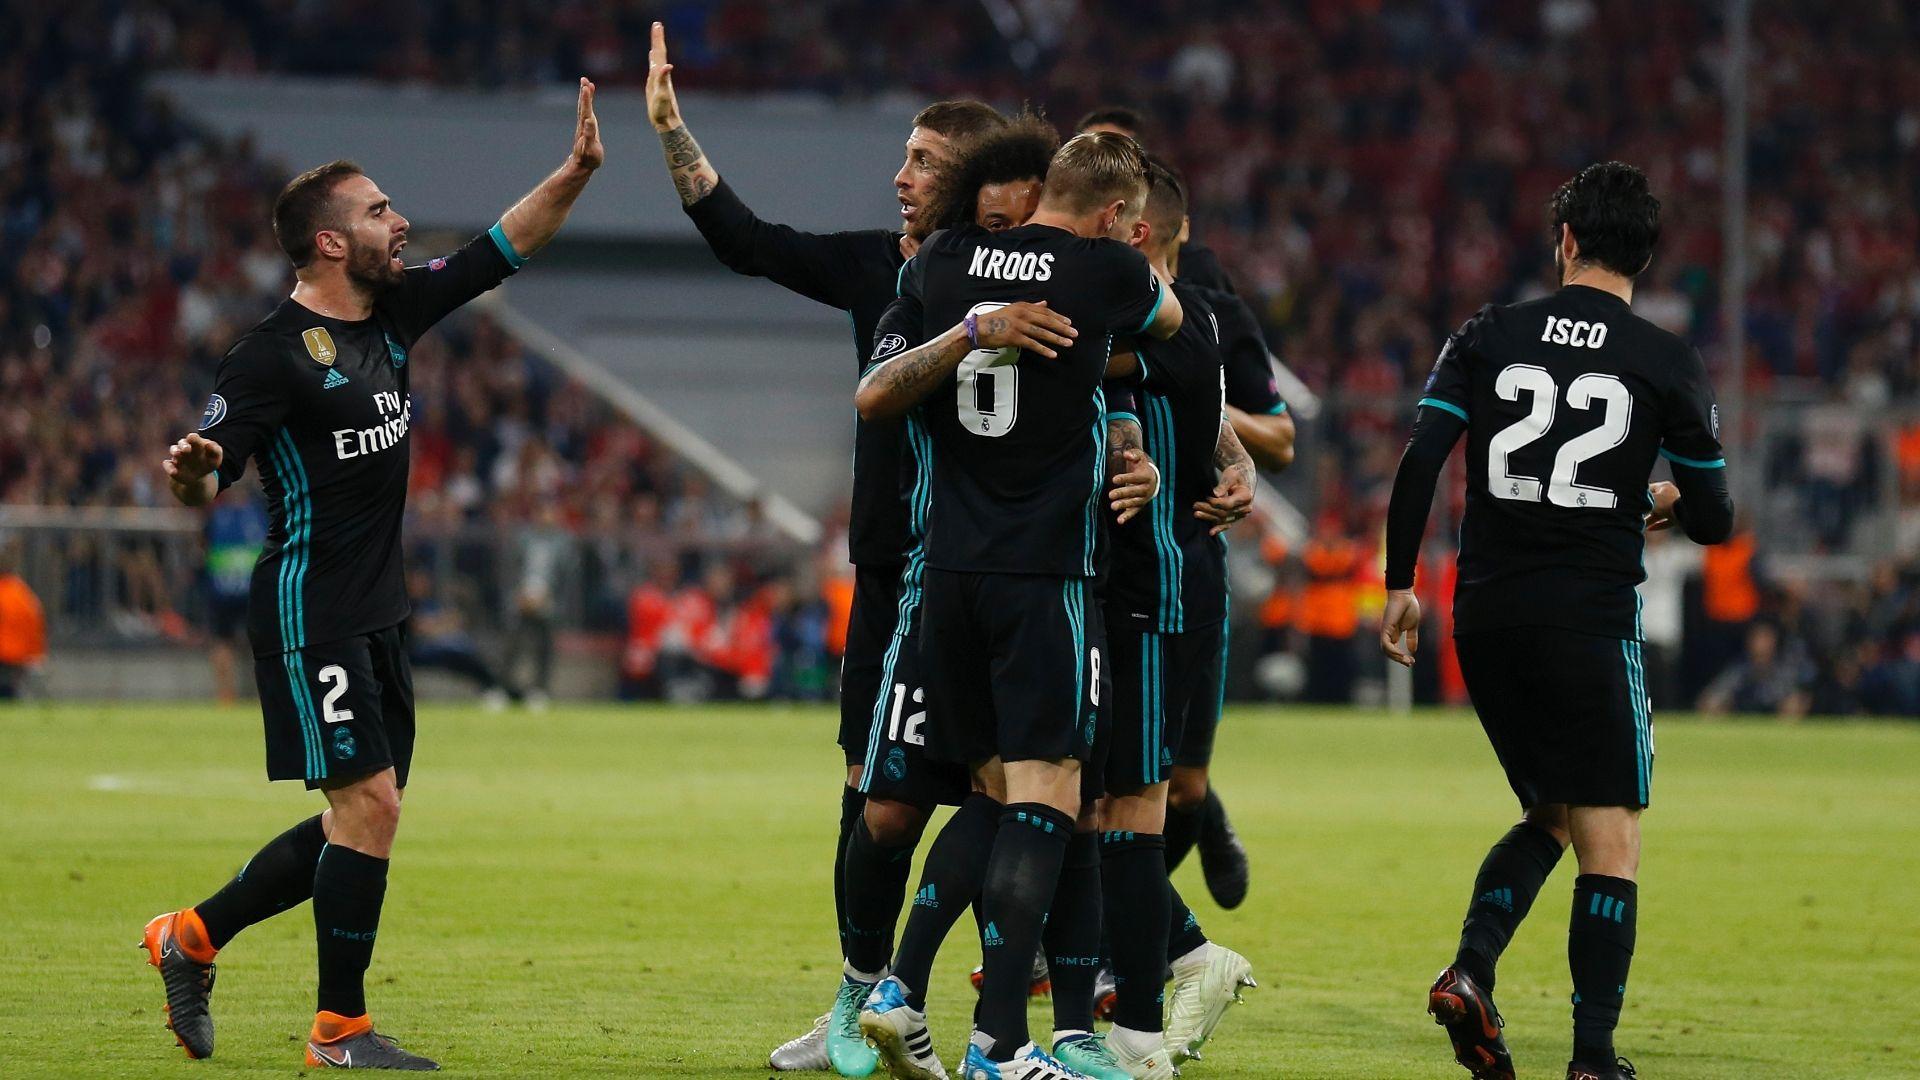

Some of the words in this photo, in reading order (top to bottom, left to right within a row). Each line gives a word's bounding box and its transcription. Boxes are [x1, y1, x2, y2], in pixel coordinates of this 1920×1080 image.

[968, 246, 1055, 282] KROOS
[1541, 315, 1608, 349] ISCO
[323, 377, 349, 390] adidas
[373, 391, 401, 415] Fly
[1488, 363, 1634, 509] 22
[318, 664, 354, 723] 2
[1090, 646, 1100, 707] 8
[888, 683, 927, 746] 12
